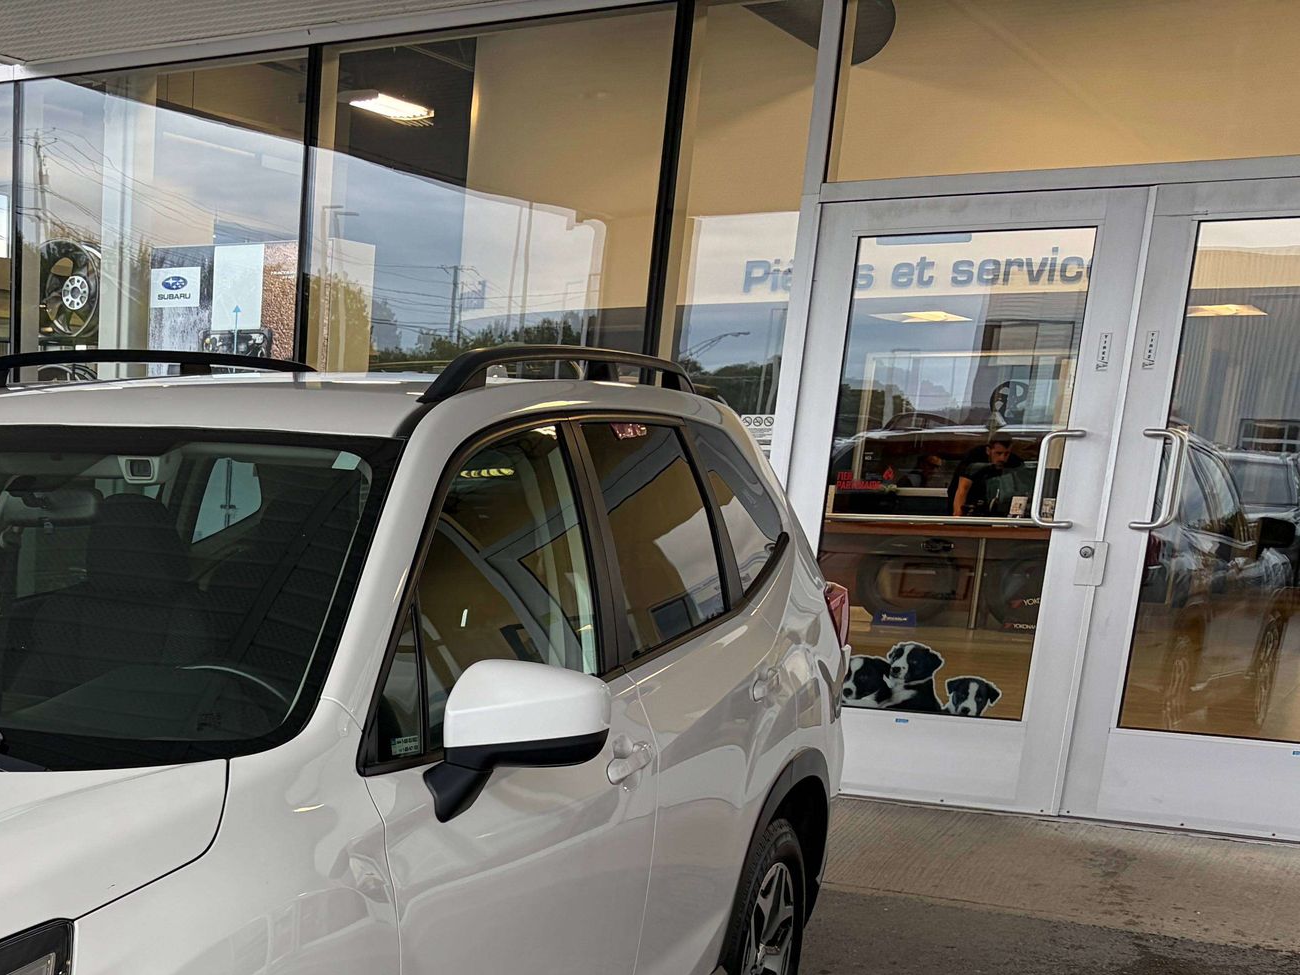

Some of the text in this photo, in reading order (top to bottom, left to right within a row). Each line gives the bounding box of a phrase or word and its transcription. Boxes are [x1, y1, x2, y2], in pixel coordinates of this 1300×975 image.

[891, 256, 936, 289] et
[951, 247, 1092, 287] servic
[157, 292, 191, 301] SUBARU
